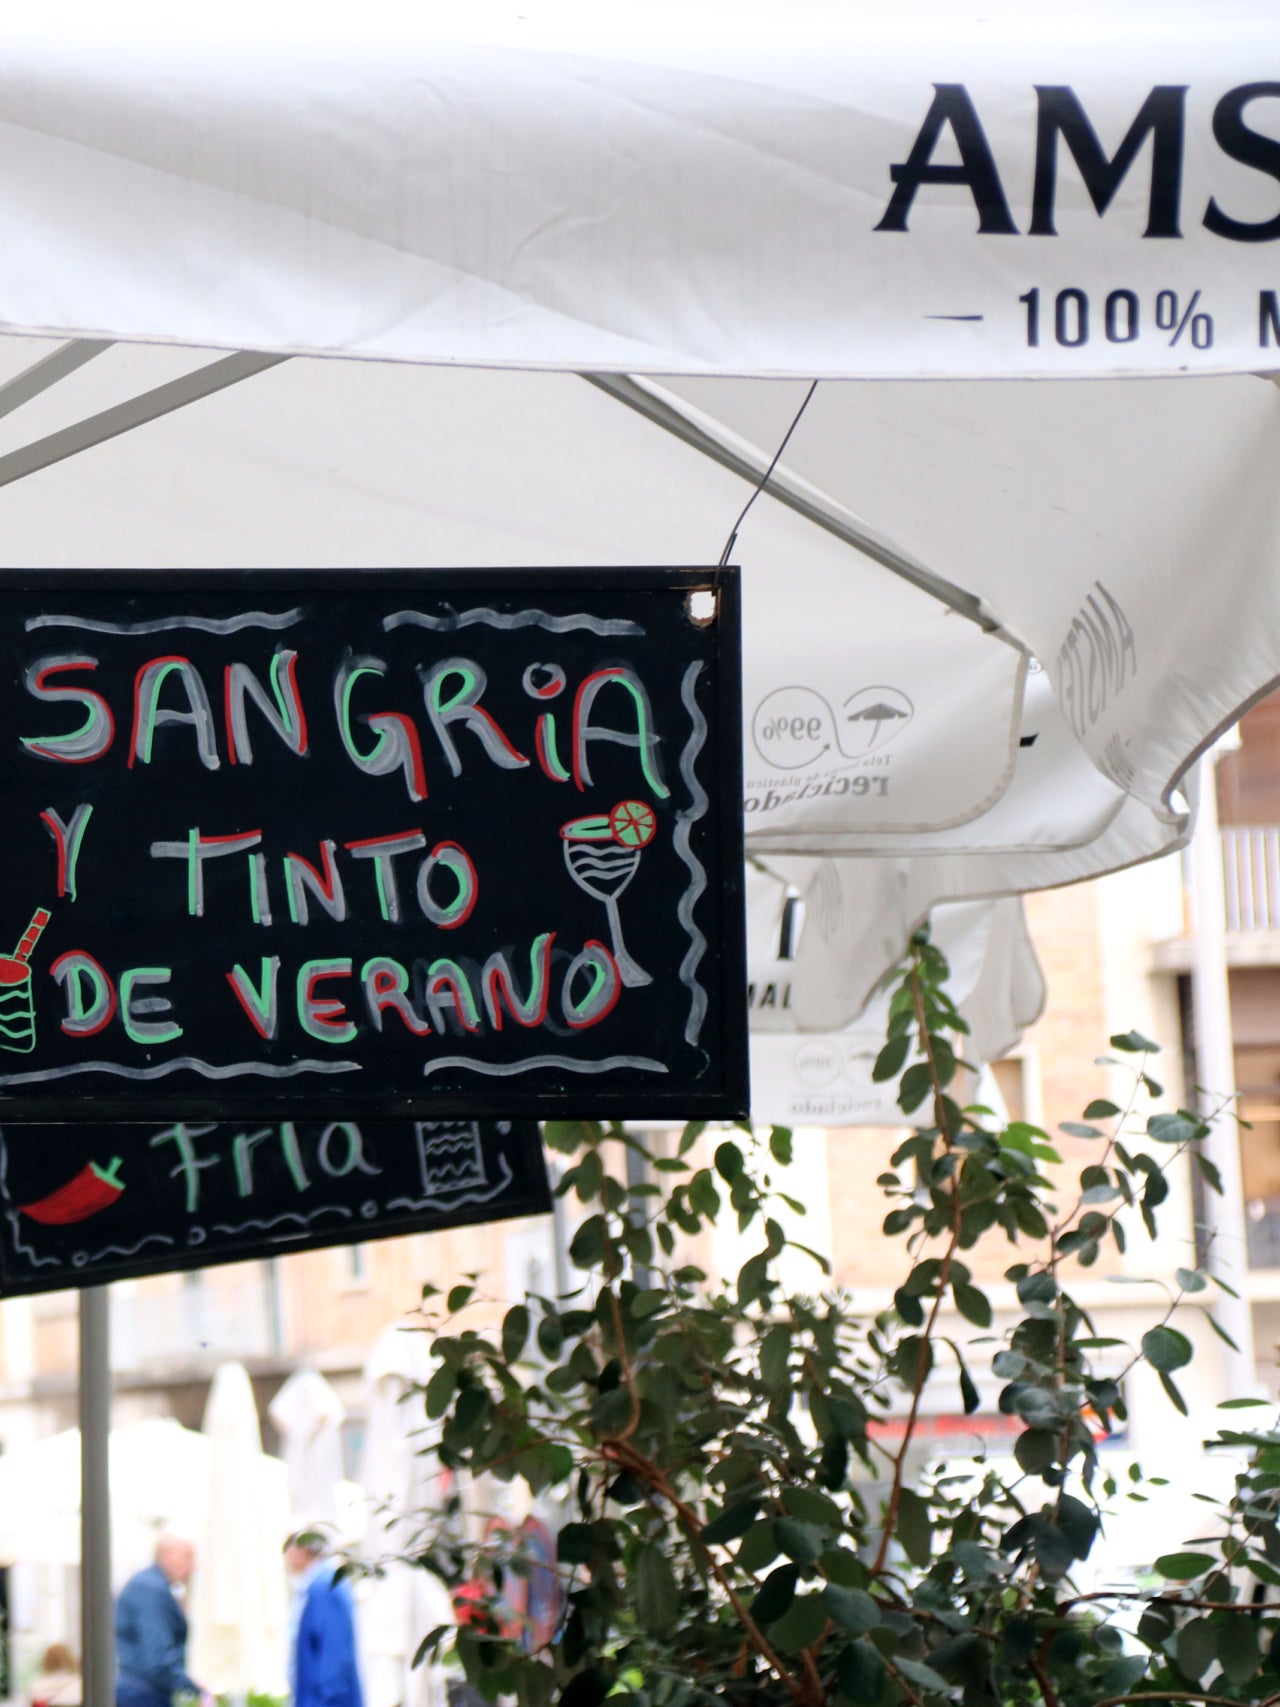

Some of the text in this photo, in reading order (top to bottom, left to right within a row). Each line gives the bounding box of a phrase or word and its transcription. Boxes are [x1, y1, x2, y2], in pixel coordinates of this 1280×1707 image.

[872, 81, 1280, 243] AMS
[1019, 286, 1215, 350] 100%
[39, 803, 478, 930] Y TINTO
[49, 932, 622, 1045] DE VERANO
